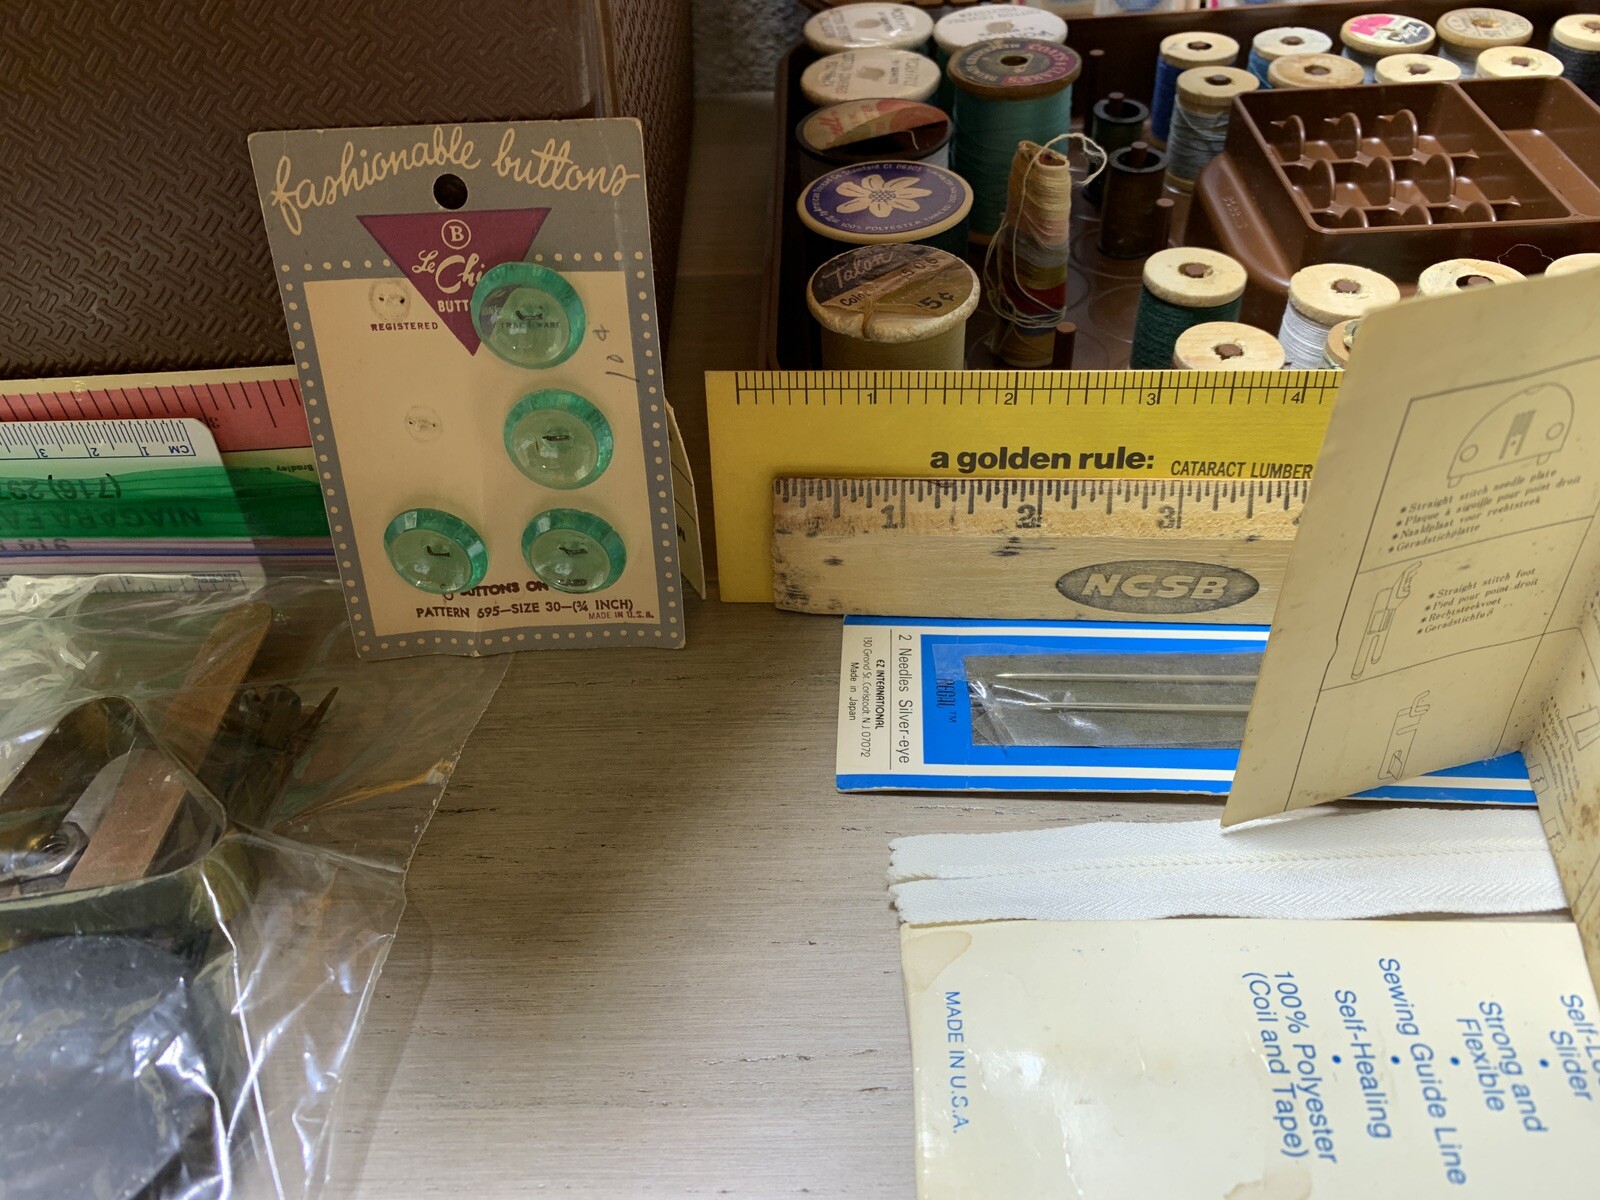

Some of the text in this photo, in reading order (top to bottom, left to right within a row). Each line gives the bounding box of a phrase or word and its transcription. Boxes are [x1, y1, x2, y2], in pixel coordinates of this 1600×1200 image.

[270, 126, 642, 235] fashionable buttons
[864, 219, 921, 232] POLYESTER
[411, 249, 437, 274] Le
[821, 251, 894, 289] Talon
[370, 322, 439, 332] REGISTERED
[867, 392, 873, 405] 1
[1003, 391, 1014, 405] 2
[1146, 392, 1157, 406] 3
[1290, 391, 1301, 404] 4
[38, 448, 49, 459] 3
[90, 447, 101, 457] 2
[142, 446, 150, 457] 1
[168, 444, 190, 455] CM
[930, 446, 1154, 473] a golden rule:
[275, 464, 314, 473] Bradley
[1170, 460, 1314, 480] CATARACT LUMBER
[1404, 510, 1440, 527] Plaque
[1496, 491, 1521, 505] pour
[1524, 482, 1551, 500] point
[1555, 475, 1582, 489] droit
[1408, 469, 1557, 514] Straight stitch needle plate
[47, 507, 204, 530] NIAGARA
[880, 504, 899, 529] 1
[1015, 504, 1037, 529] 2
[1156, 505, 1176, 530] 3
[526, 580, 549, 592] ON
[1081, 573, 1229, 600] NCSB
[1432, 577, 1539, 611] Pied pour point droit
[1435, 567, 1536, 599] Straight stitch foot
[416, 606, 470, 618] PATTERN
[595, 598, 634, 612] INCH)
[588, 610, 655, 620] MADE IN U.S.A.
[1428, 597, 1502, 623] Rechtsteekvoet
[863, 636, 873, 647] 130
[898, 648, 913, 692] Needles
[848, 661, 860, 721] Made in Japan
[874, 659, 886, 730] EZ INTERNATIONAL
[860, 731, 872, 758] 07072
[895, 699, 914, 764] Silver-eye
[1560, 993, 1600, 1076] Self-Lo
[945, 991, 970, 1134] MADE IN U.S.A.
[1242, 971, 1311, 1159] (Coil and Tape)
[1273, 970, 1338, 1164] 100% Polyester
[1334, 989, 1393, 1139] Self-Healing
[1378, 957, 1468, 1186] Sewing Guide Line
[1456, 1017, 1505, 1112] Flexible
[1479, 1001, 1549, 1133] Strong and
[1550, 1030, 1592, 1102] Slider
